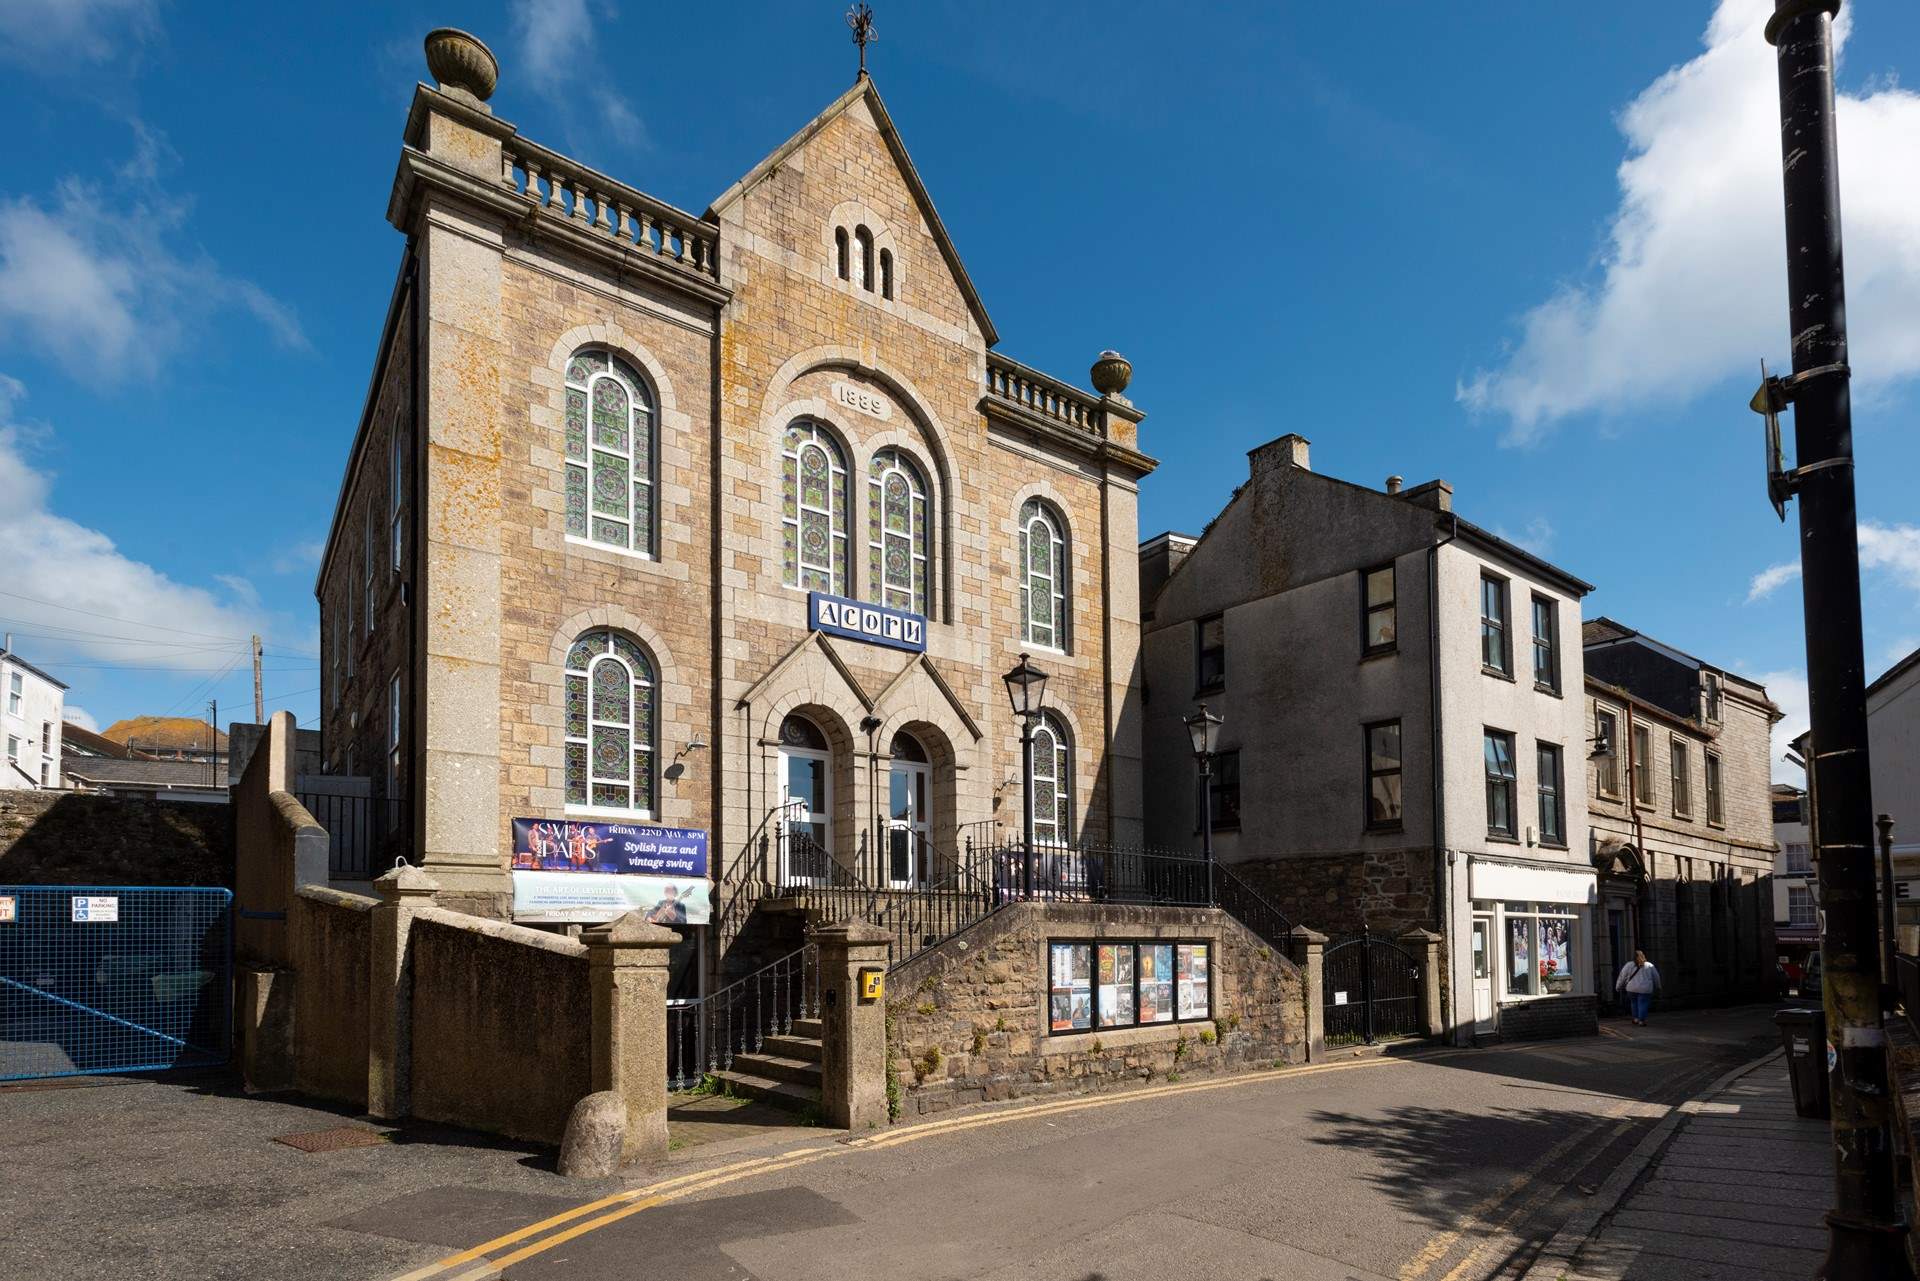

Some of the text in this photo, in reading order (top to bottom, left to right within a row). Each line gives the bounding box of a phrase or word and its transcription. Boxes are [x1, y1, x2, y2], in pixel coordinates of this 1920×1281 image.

[608, 824, 637, 835] FRIDAY
[641, 828, 662, 837] 22ND
[687, 832, 705, 840] 8PM
[624, 841, 698, 855] Stylish jazz and
[628, 857, 694, 871] vintage swing
